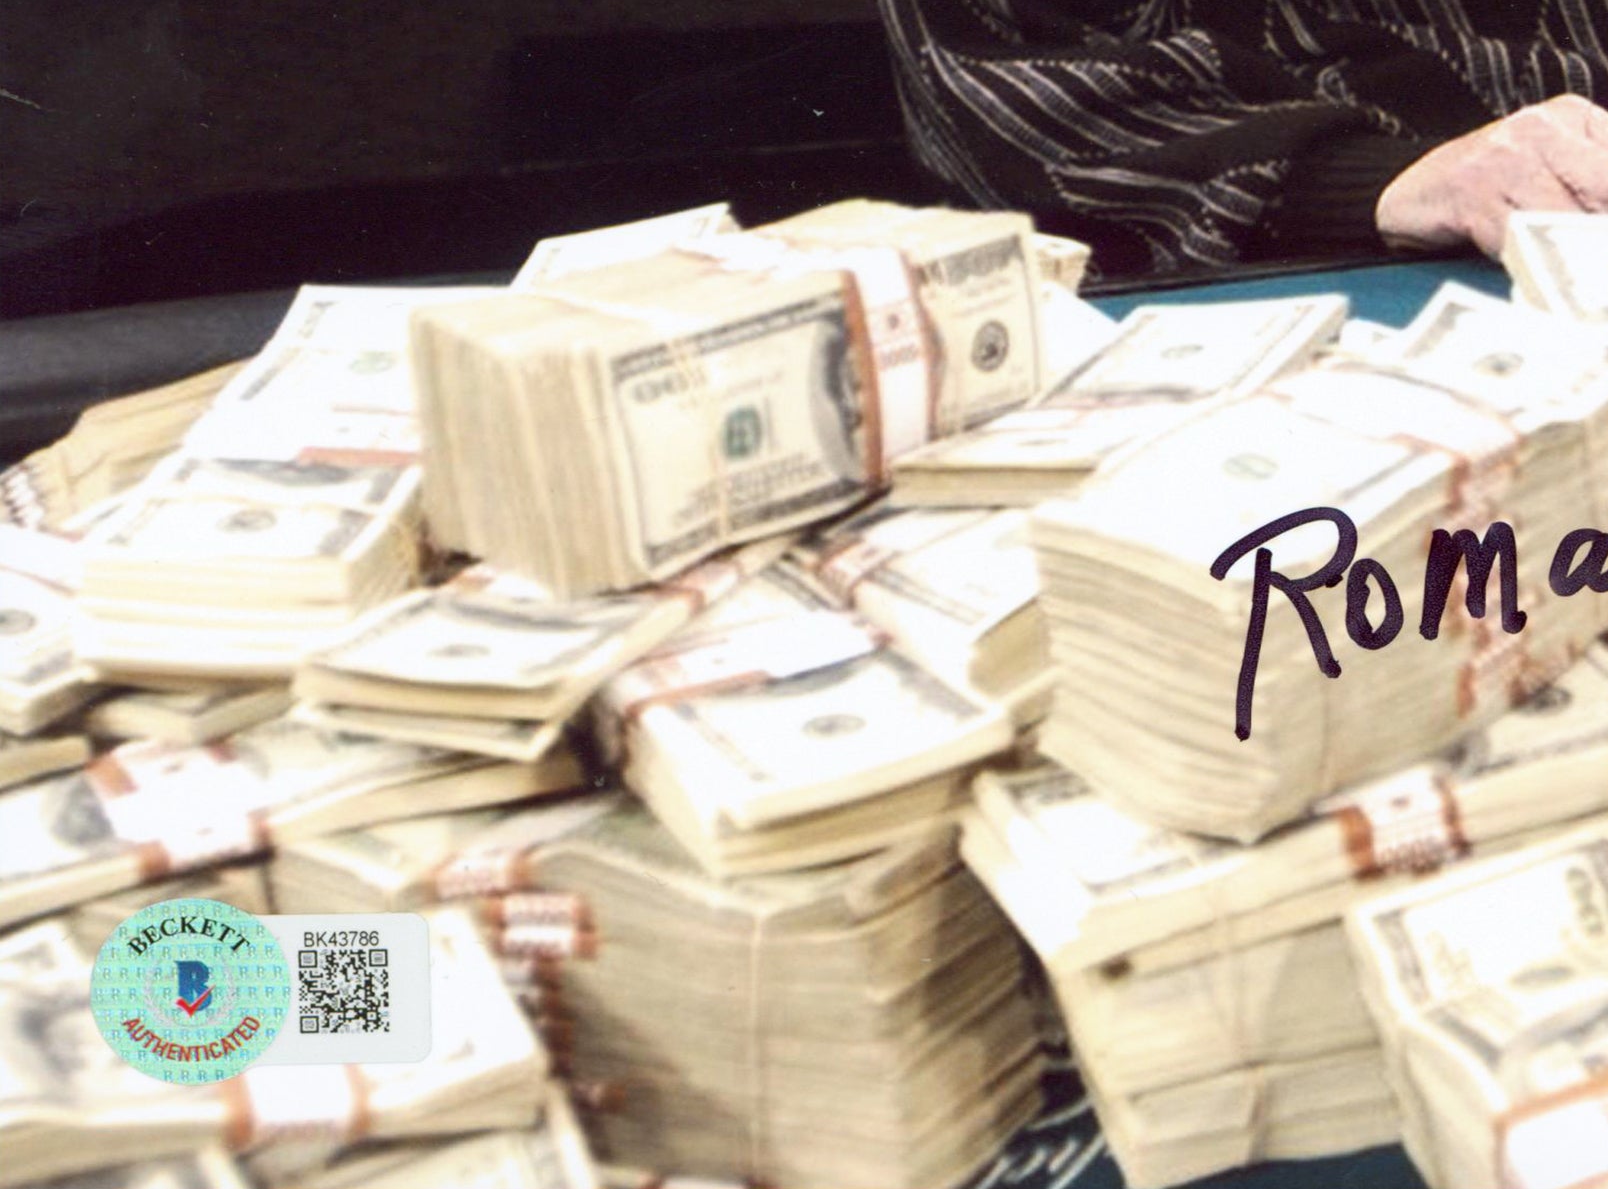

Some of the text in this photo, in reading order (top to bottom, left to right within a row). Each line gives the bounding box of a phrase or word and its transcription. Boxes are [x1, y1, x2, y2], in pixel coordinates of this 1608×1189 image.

[127, 915, 251, 957] BECKETT
[303, 930, 380, 948] BK43786
[122, 1015, 261, 1062] AUTHENTICATED
